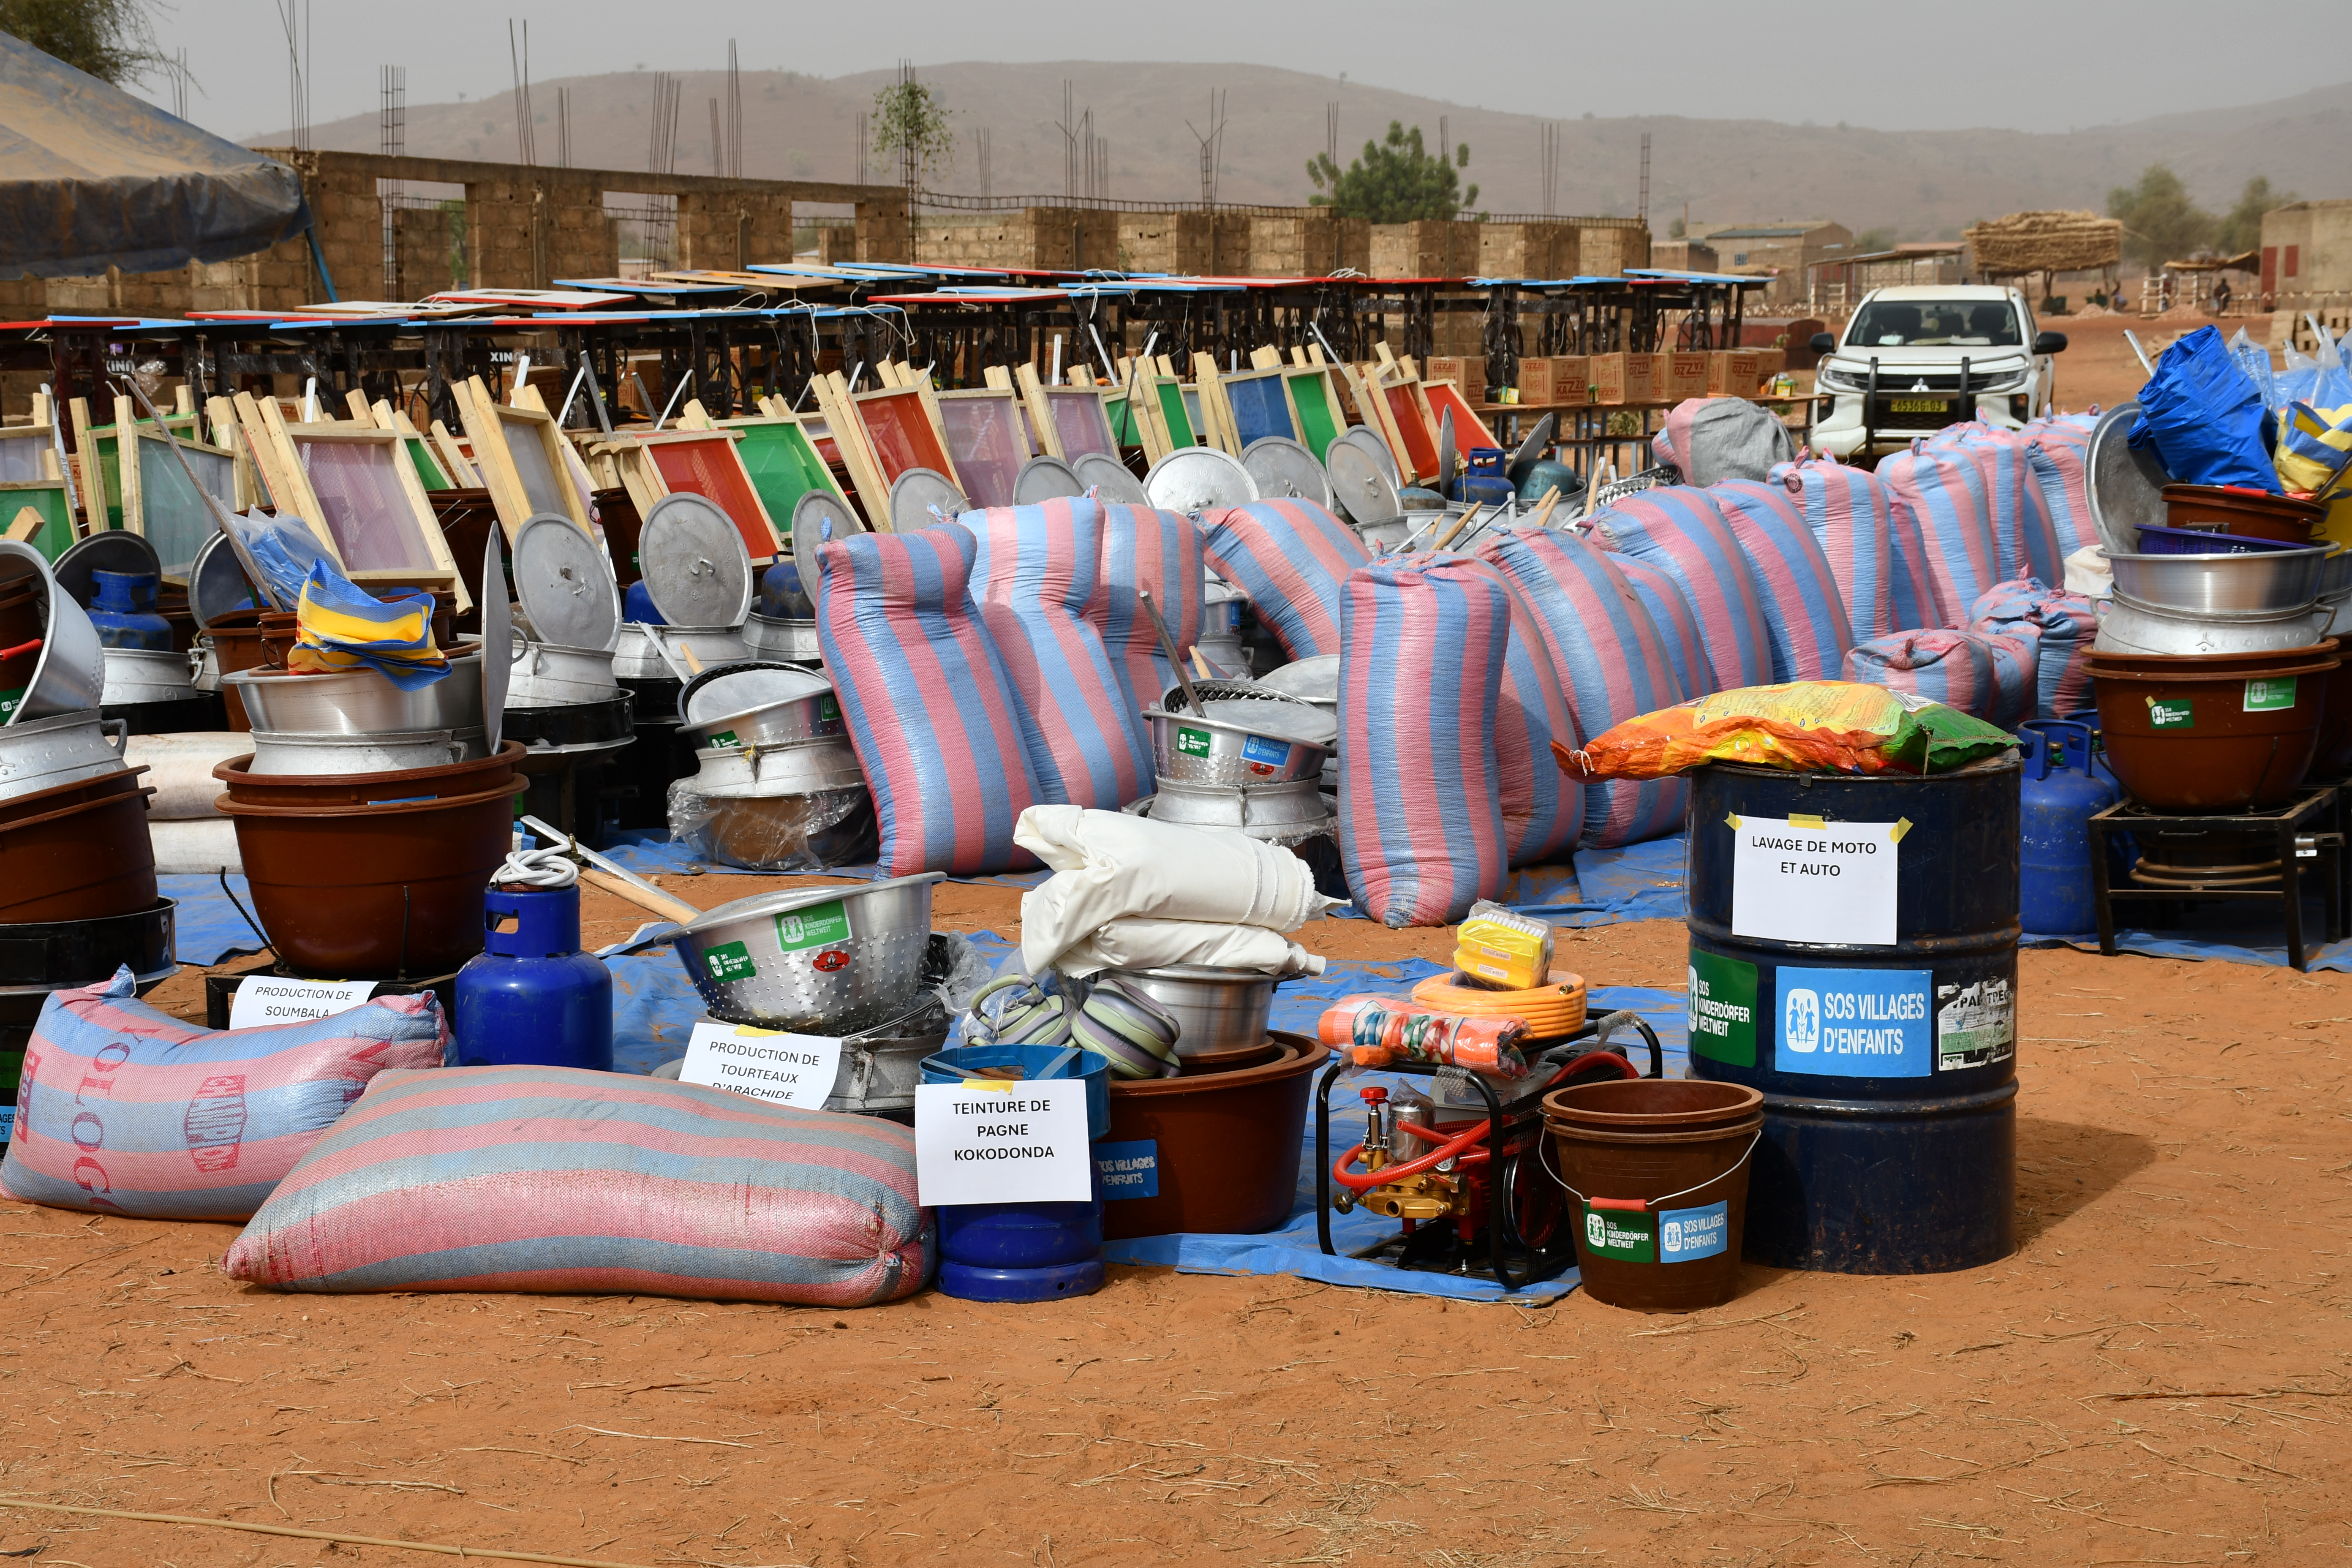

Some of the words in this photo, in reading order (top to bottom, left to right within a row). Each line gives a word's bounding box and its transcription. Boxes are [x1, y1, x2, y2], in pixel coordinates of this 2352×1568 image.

[1674, 362, 1704, 375] KAZZO
[1557, 380, 1584, 395] KAZZO
[1260, 739, 1269, 748] SOS
[1269, 741, 1288, 751] VILLAGES
[1257, 748, 1279, 759] D'ENFANTS
[1752, 836, 1803, 852] LAVAGE
[1808, 841, 1827, 853] DE
[1832, 842, 1876, 855] MOTO
[1780, 862, 1796, 874] ET
[1800, 864, 1841, 877] AUTO
[804, 915, 842, 929] KINDERDÖRFER
[806, 926, 831, 937] WELTWEIT
[256, 987, 333, 1000] PRODUCTION
[336, 991, 353, 1000] DE
[1699, 980, 1709, 997] SOS
[265, 1006, 329, 1019] SOUMBALA
[1699, 997, 1750, 1023] KINDERDÖRFER
[1824, 993, 1855, 1019] SOS
[1858, 993, 1925, 1021] VILLAGES
[1699, 1021, 1729, 1037] WELTWEIT
[1824, 1028, 1903, 1055] D'ENFANTS
[710, 1041, 798, 1064] PRODUCTION
[802, 1054, 820, 1066] DE
[721, 1064, 799, 1084] TOURTEAUX
[953, 1101, 1026, 1115] TEINTURE
[1031, 1100, 1051, 1112] DE
[977, 1124, 1029, 1137] PAGNE
[954, 1146, 1054, 1161] KOKODONDA
[1606, 1221, 1617, 1230] SOS
[1684, 1220, 1697, 1234] SOS
[1698, 1212, 1724, 1231] VILLAGES
[1607, 1229, 1649, 1241] KINDERDÖRFER
[1684, 1232, 1717, 1250] D'ENFANTS
[1607, 1239, 1634, 1249] WELTWEIT
